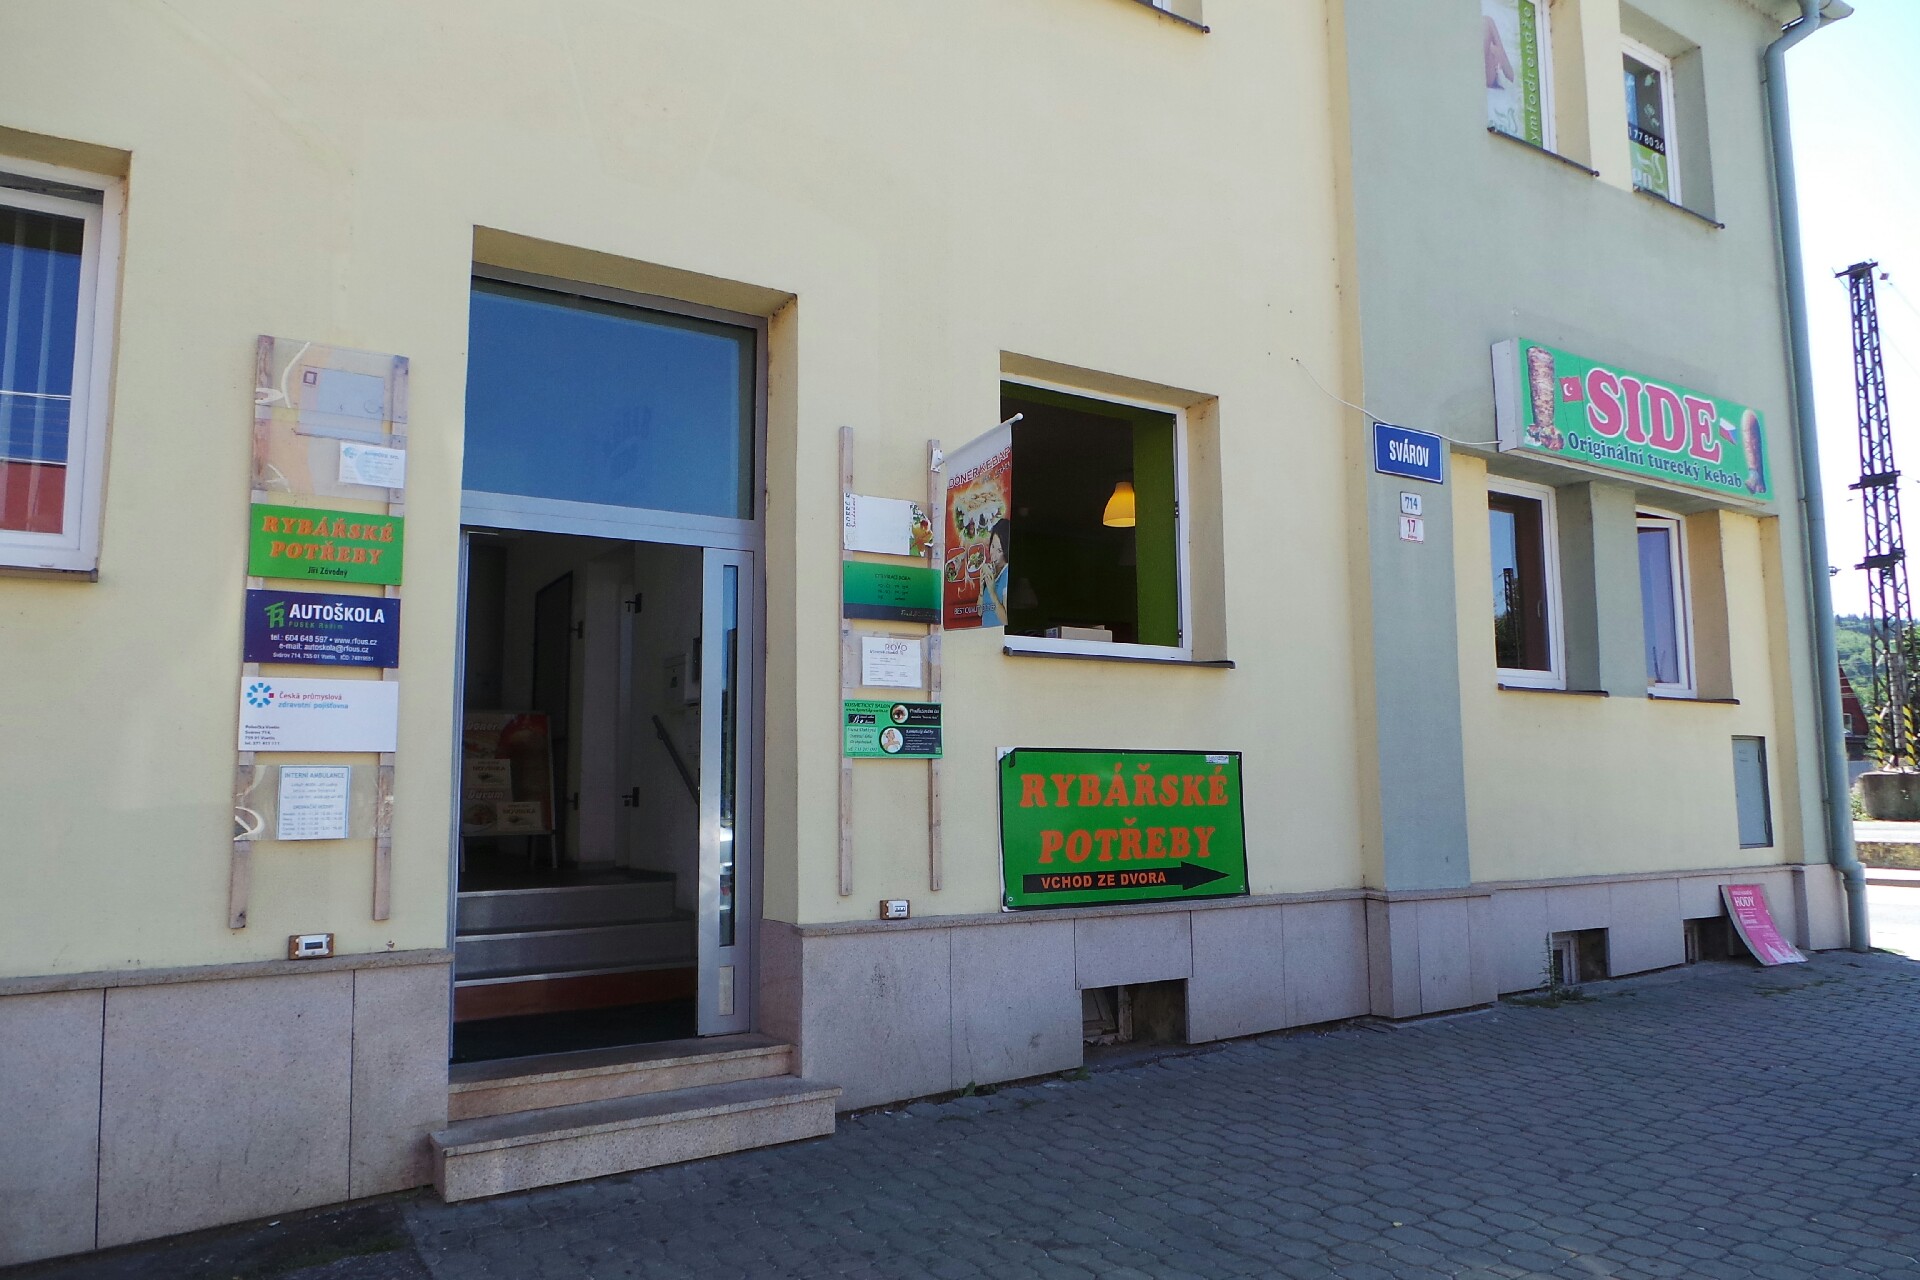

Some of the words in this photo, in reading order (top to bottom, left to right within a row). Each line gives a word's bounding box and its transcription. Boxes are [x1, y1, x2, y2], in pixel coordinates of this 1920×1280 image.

[1586, 368, 1722, 464] SIDE
[1389, 438, 1430, 468] SVÁROV
[1568, 432, 1644, 466] Originální
[1647, 453, 1700, 480] turecký
[1704, 464, 1742, 488] kebab
[1405, 496, 1418, 511] 714
[262, 515, 395, 543] RYBÁŘSKÉ
[1407, 519, 1416, 533] 17
[269, 541, 384, 565] POTŘEBY
[320, 567, 348, 578] Závodný
[289, 602, 385, 623] AUTOŠKOLA
[314, 635, 329, 643] 597
[278, 700, 311, 709] zdravotní
[313, 701, 349, 711] pojišťovna
[279, 691, 300, 700] Česká
[302, 691, 342, 702] průmyslová
[1019, 762, 1229, 808] RYBÁŘSKÉ
[1038, 817, 1216, 864] POTŘEBY
[1041, 874, 1093, 890] VCHOD
[1097, 874, 1116, 887] ZE
[1120, 871, 1167, 886] DVORA
